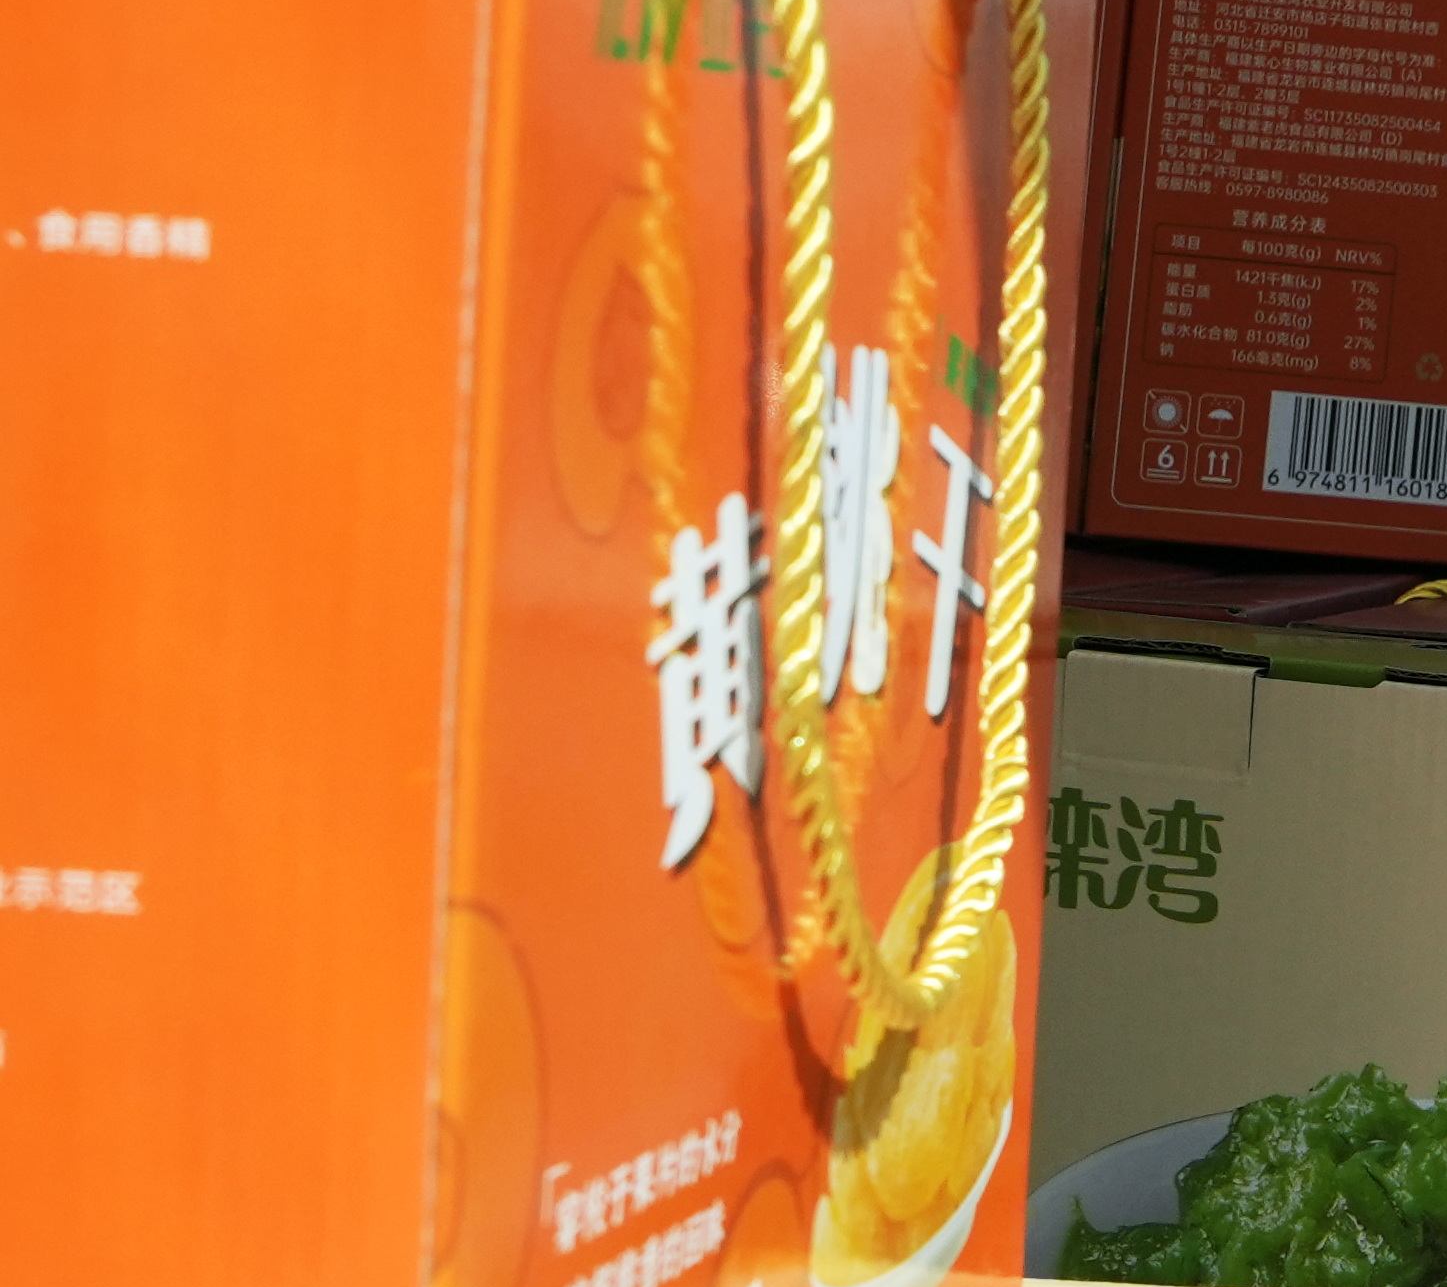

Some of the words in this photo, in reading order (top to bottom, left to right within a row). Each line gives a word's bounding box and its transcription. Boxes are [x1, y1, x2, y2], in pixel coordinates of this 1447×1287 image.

[1232, 209, 1327, 235] 营养成分表
[1171, 233, 1201, 251] 项目
[1335, 248, 1383, 266] NRV%
[1167, 262, 1197, 279] 能量
[1351, 279, 1379, 296] 17%
[1165, 281, 1211, 300] 蛋白质
[1355, 297, 1377, 313] 2%
[1162, 301, 1192, 318] 脂肪
[1358, 315, 1377, 332] 1%
[1161, 322, 1238, 343] 碳水化合物
[1344, 335, 1376, 352] 27%
[1351, 356, 1372, 371] 8%
[1267, 467, 1281, 487] 6
[1294, 469, 1372, 495] 974811
